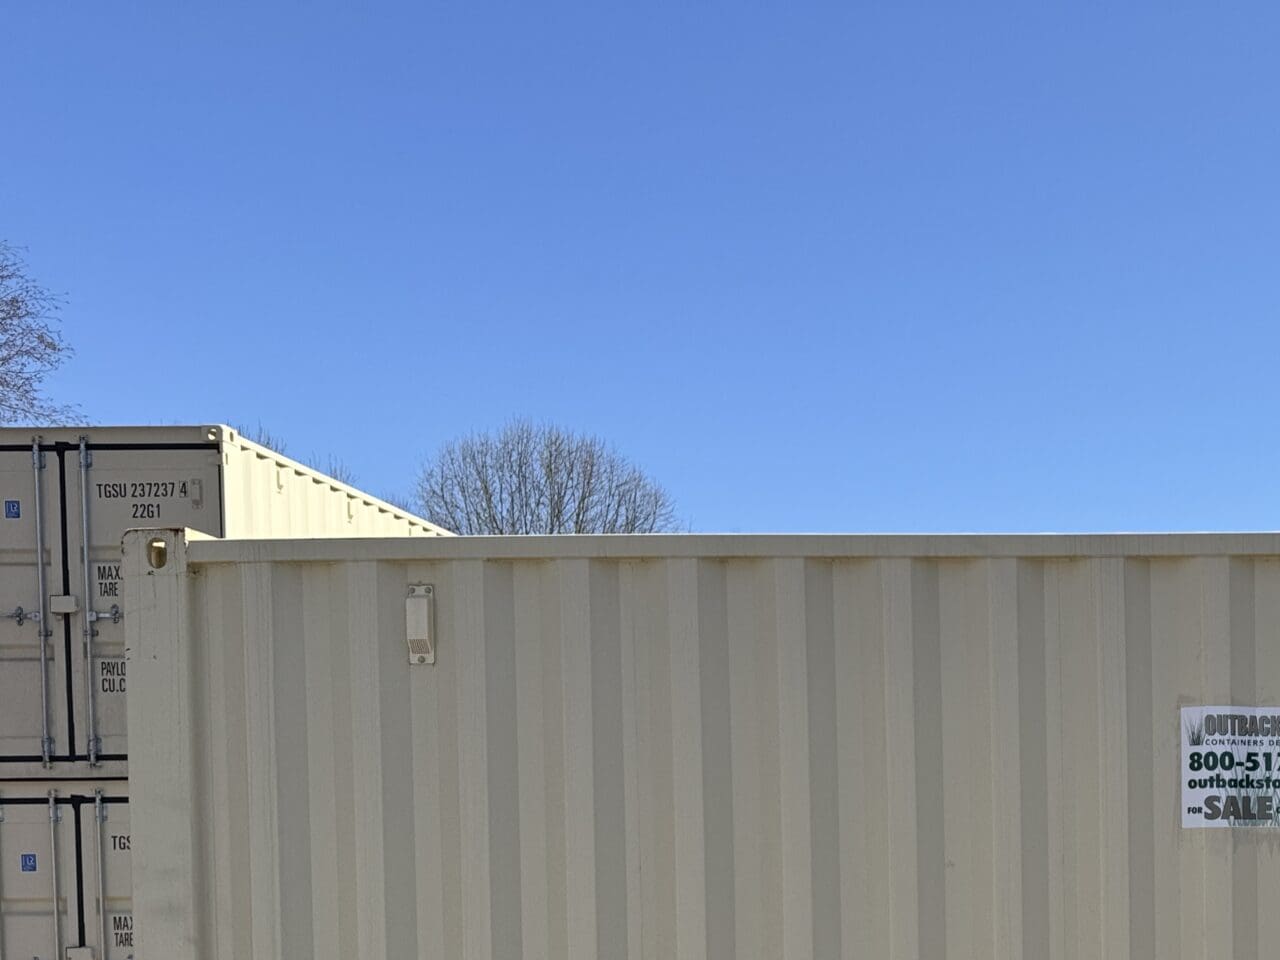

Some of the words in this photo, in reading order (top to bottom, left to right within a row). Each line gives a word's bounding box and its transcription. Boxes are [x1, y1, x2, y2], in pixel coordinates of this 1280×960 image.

[96, 483, 127, 498] TGSU
[131, 482, 175, 498] 237237
[180, 482, 187, 497] 4
[132, 503, 161, 519] 22G1
[97, 565, 123, 580] MAX.
[98, 582, 119, 597] TARE
[1205, 738, 1264, 747] CONTAINERS
[1204, 795, 1273, 820] SALE
[114, 932, 134, 947] TARE
